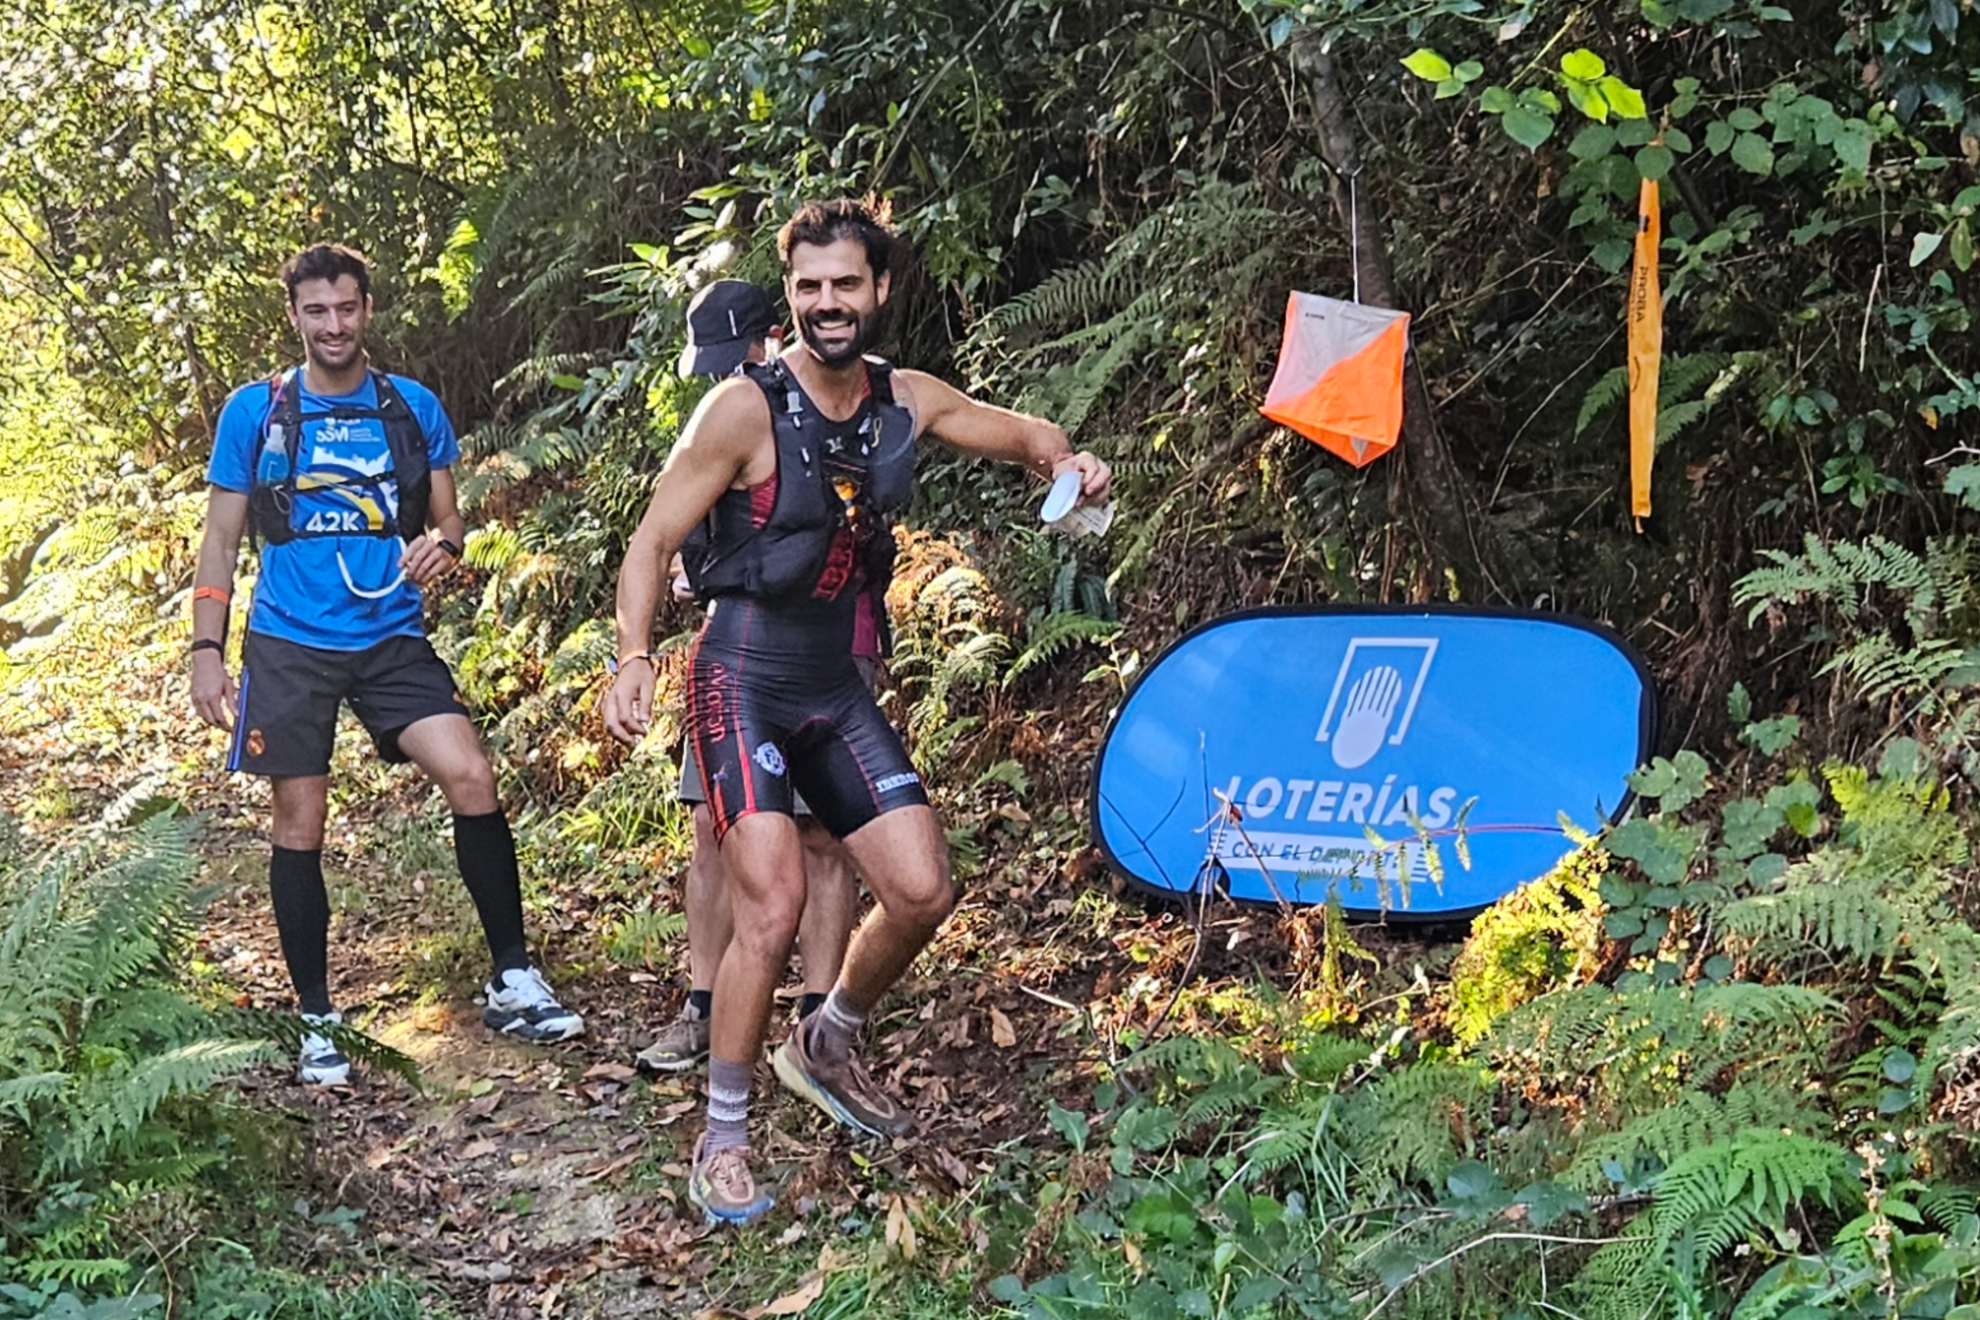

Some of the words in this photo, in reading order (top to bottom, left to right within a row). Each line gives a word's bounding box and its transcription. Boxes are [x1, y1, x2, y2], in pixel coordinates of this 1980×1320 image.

[305, 511, 360, 532] 42K
[1226, 774, 1457, 829] LOTERÍAS
[1231, 841, 1274, 858] CON
[1280, 844, 1301, 861] EL
